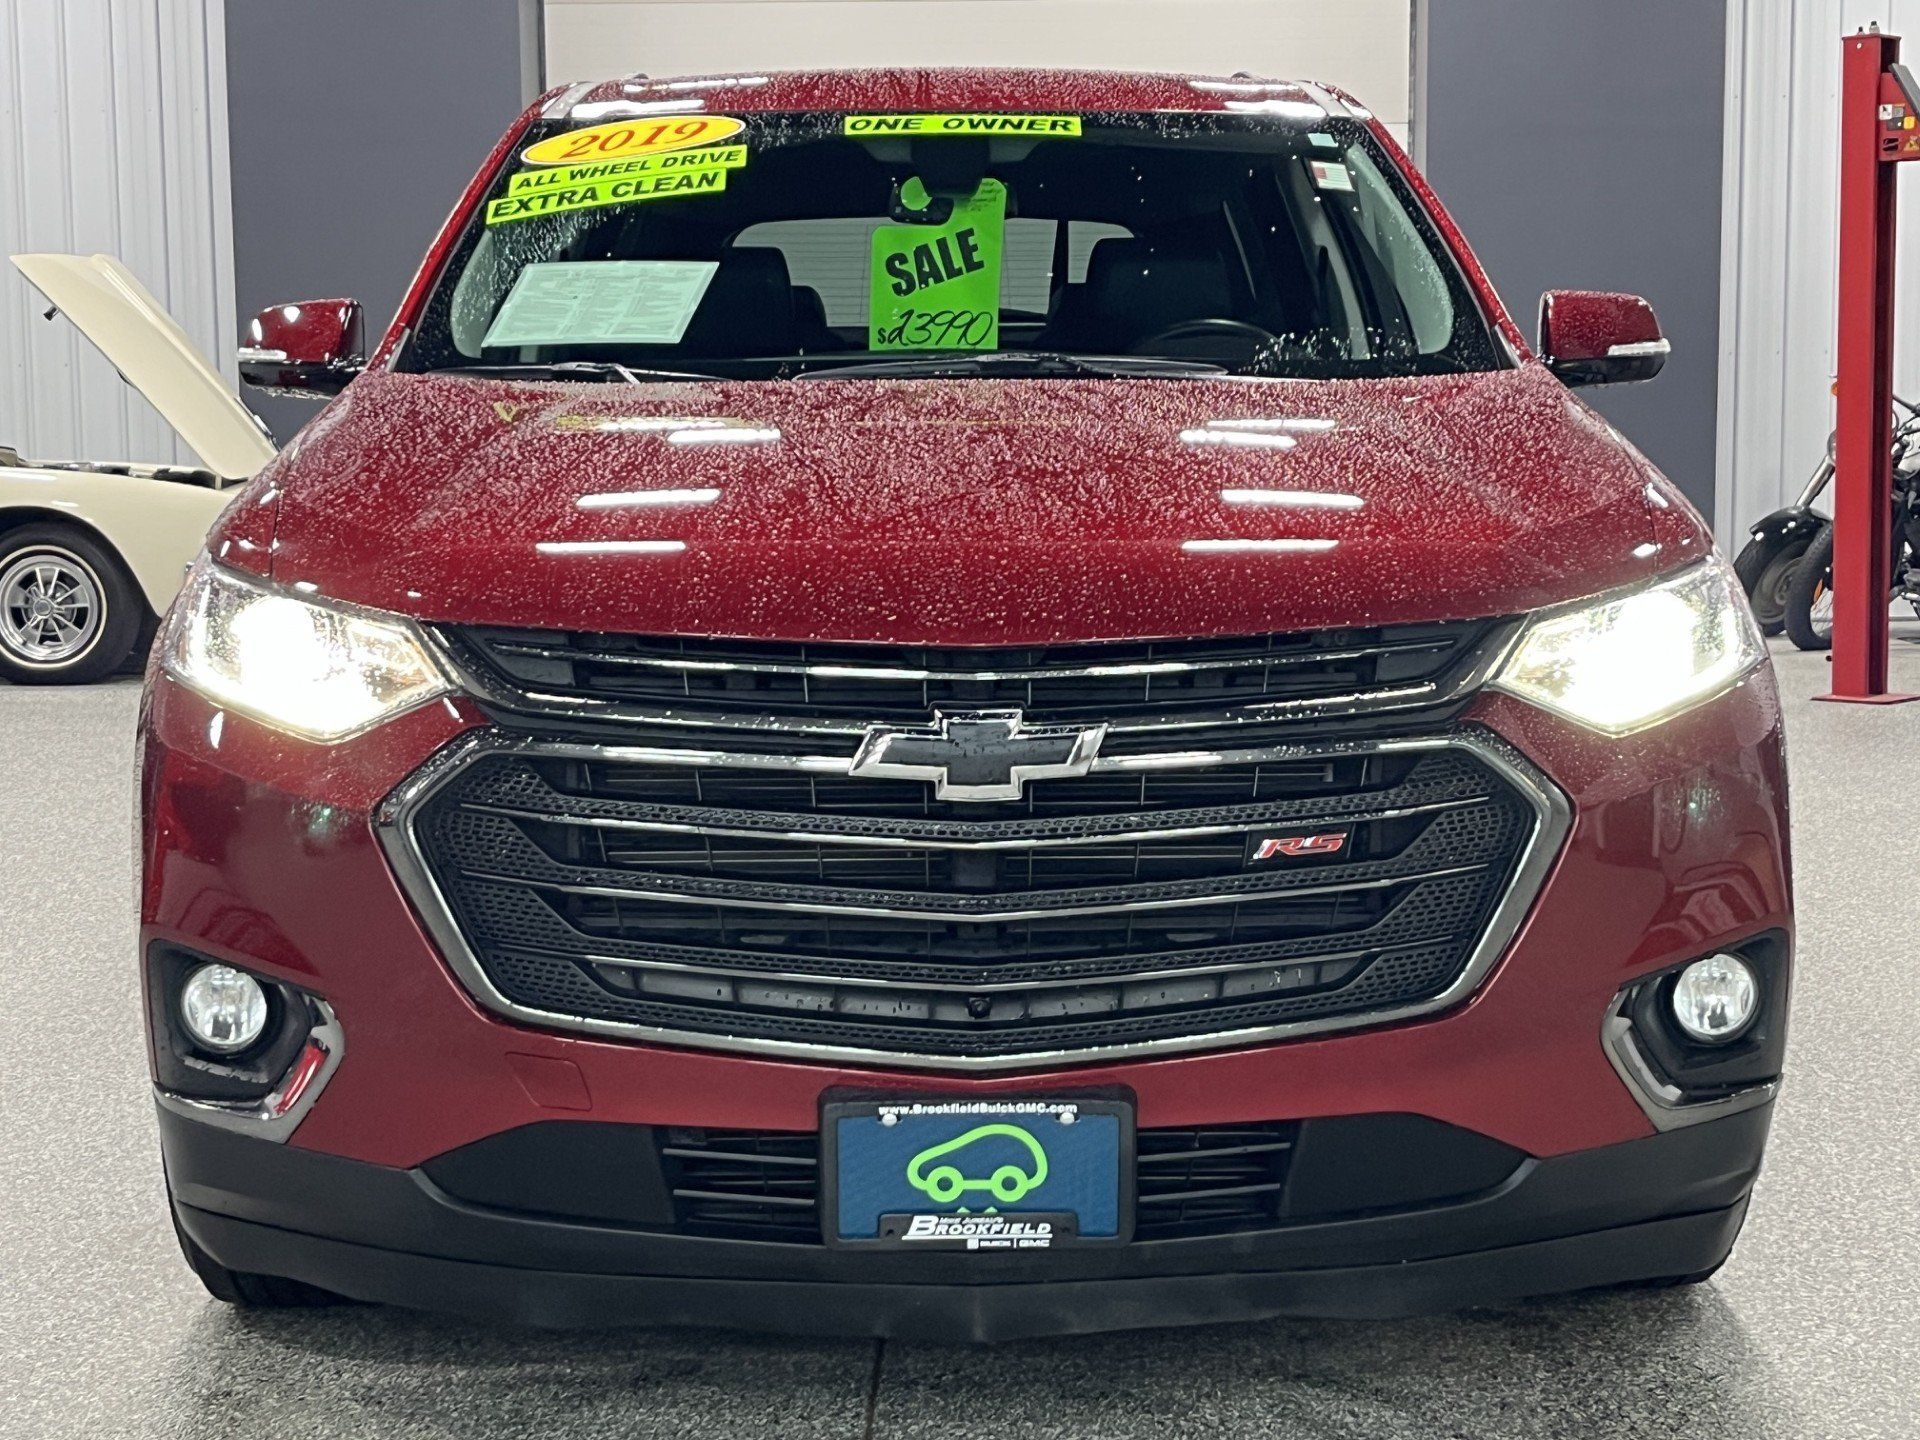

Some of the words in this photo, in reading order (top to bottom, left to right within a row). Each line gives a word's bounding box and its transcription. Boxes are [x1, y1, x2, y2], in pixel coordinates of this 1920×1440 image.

[561, 121, 708, 159] 2019
[850, 118, 923, 131] ONE
[943, 118, 1073, 132] OWNER
[516, 174, 561, 190] ALL
[569, 161, 652, 180] WHEEL
[660, 149, 742, 169] DRIVE
[491, 187, 599, 218] EXTRA
[610, 171, 719, 198] CLEAN
[885, 228, 985, 297] SALE
[1252, 832, 1348, 859] RS
[878, 1103, 1078, 1115] www.BrookfieldBuickGMC.com
